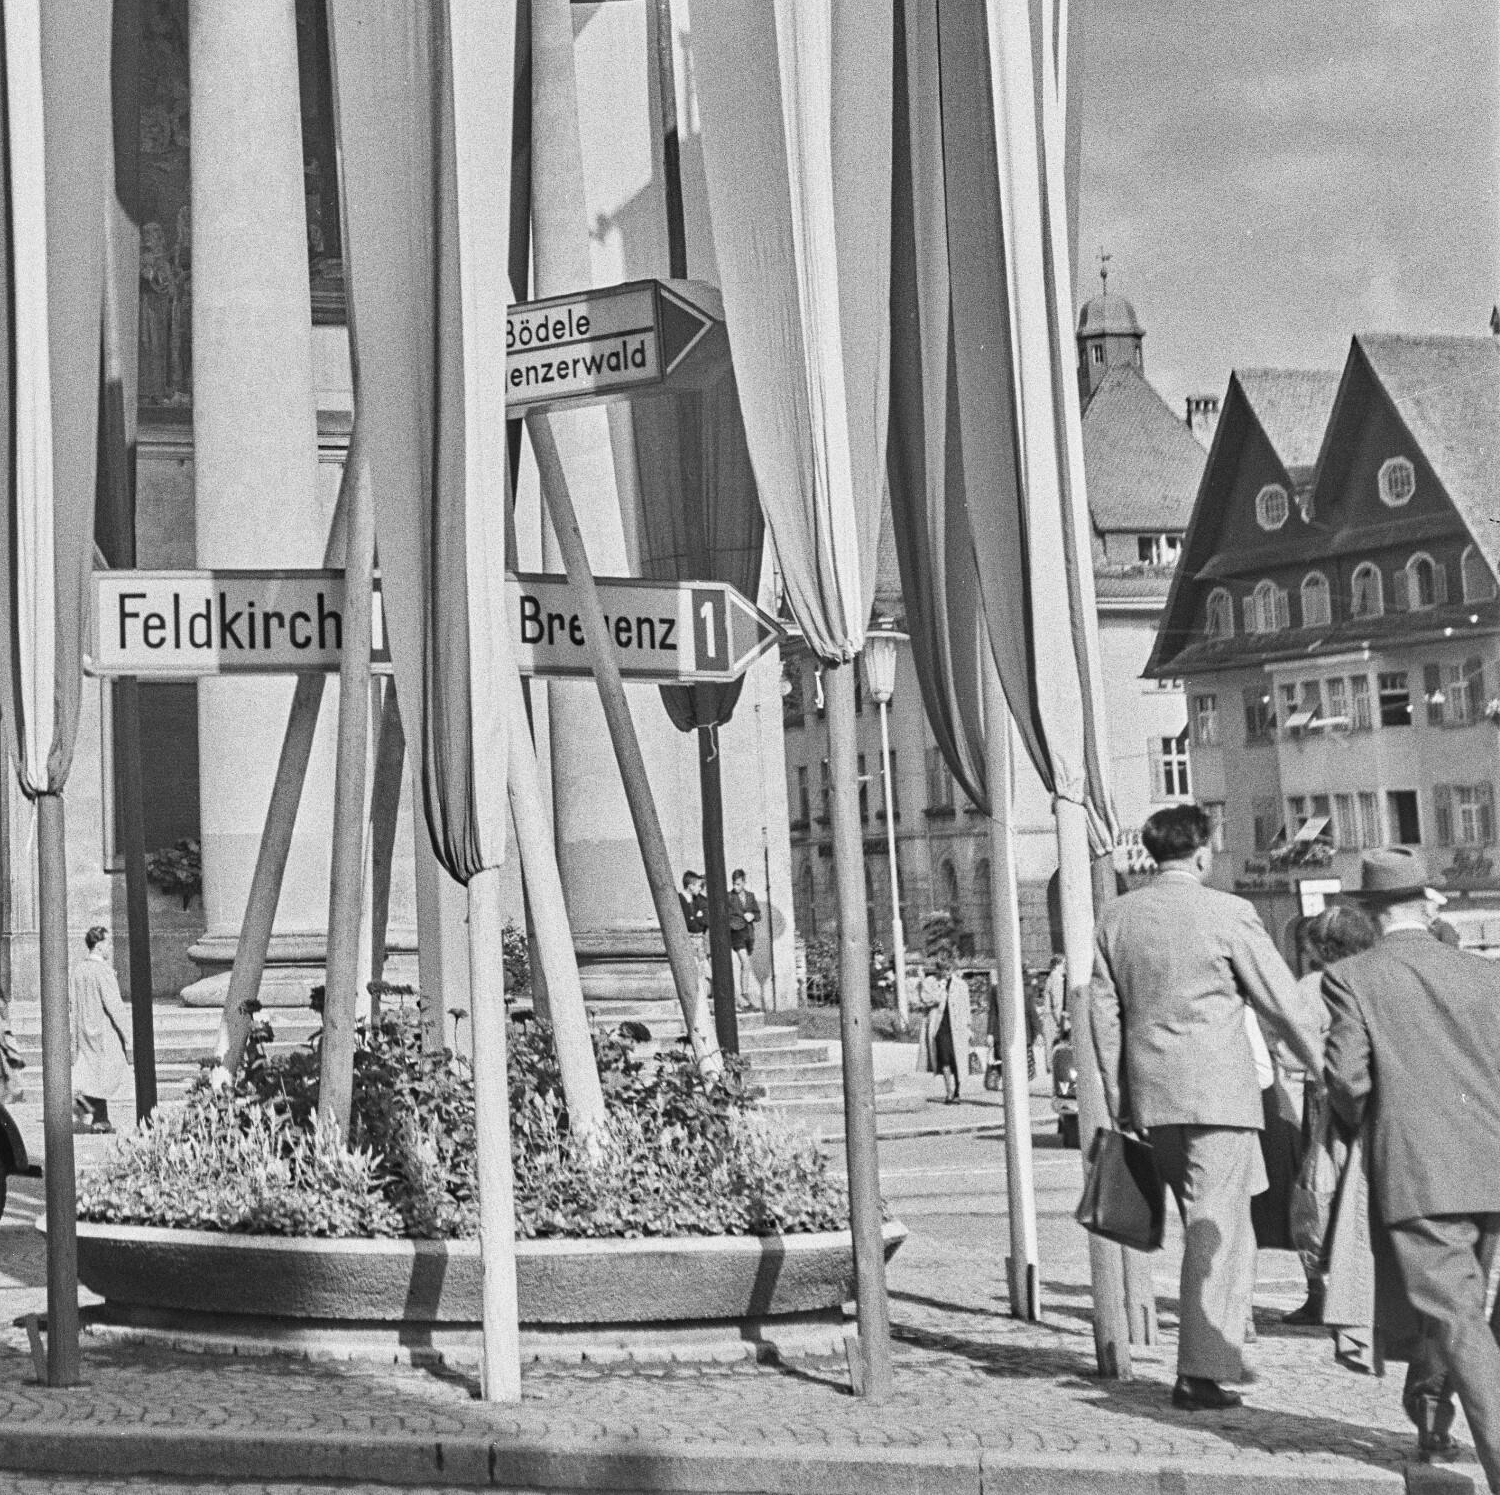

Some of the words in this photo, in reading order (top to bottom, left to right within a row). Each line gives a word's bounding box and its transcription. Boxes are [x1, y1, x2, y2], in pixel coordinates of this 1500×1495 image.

[507, 309, 590, 348] Bödele
[505, 340, 647, 393] enzerwald
[118, 592, 343, 649] Feldkirch
[520, 595, 677, 650] Breenz
[700, 601, 716, 658] 1
